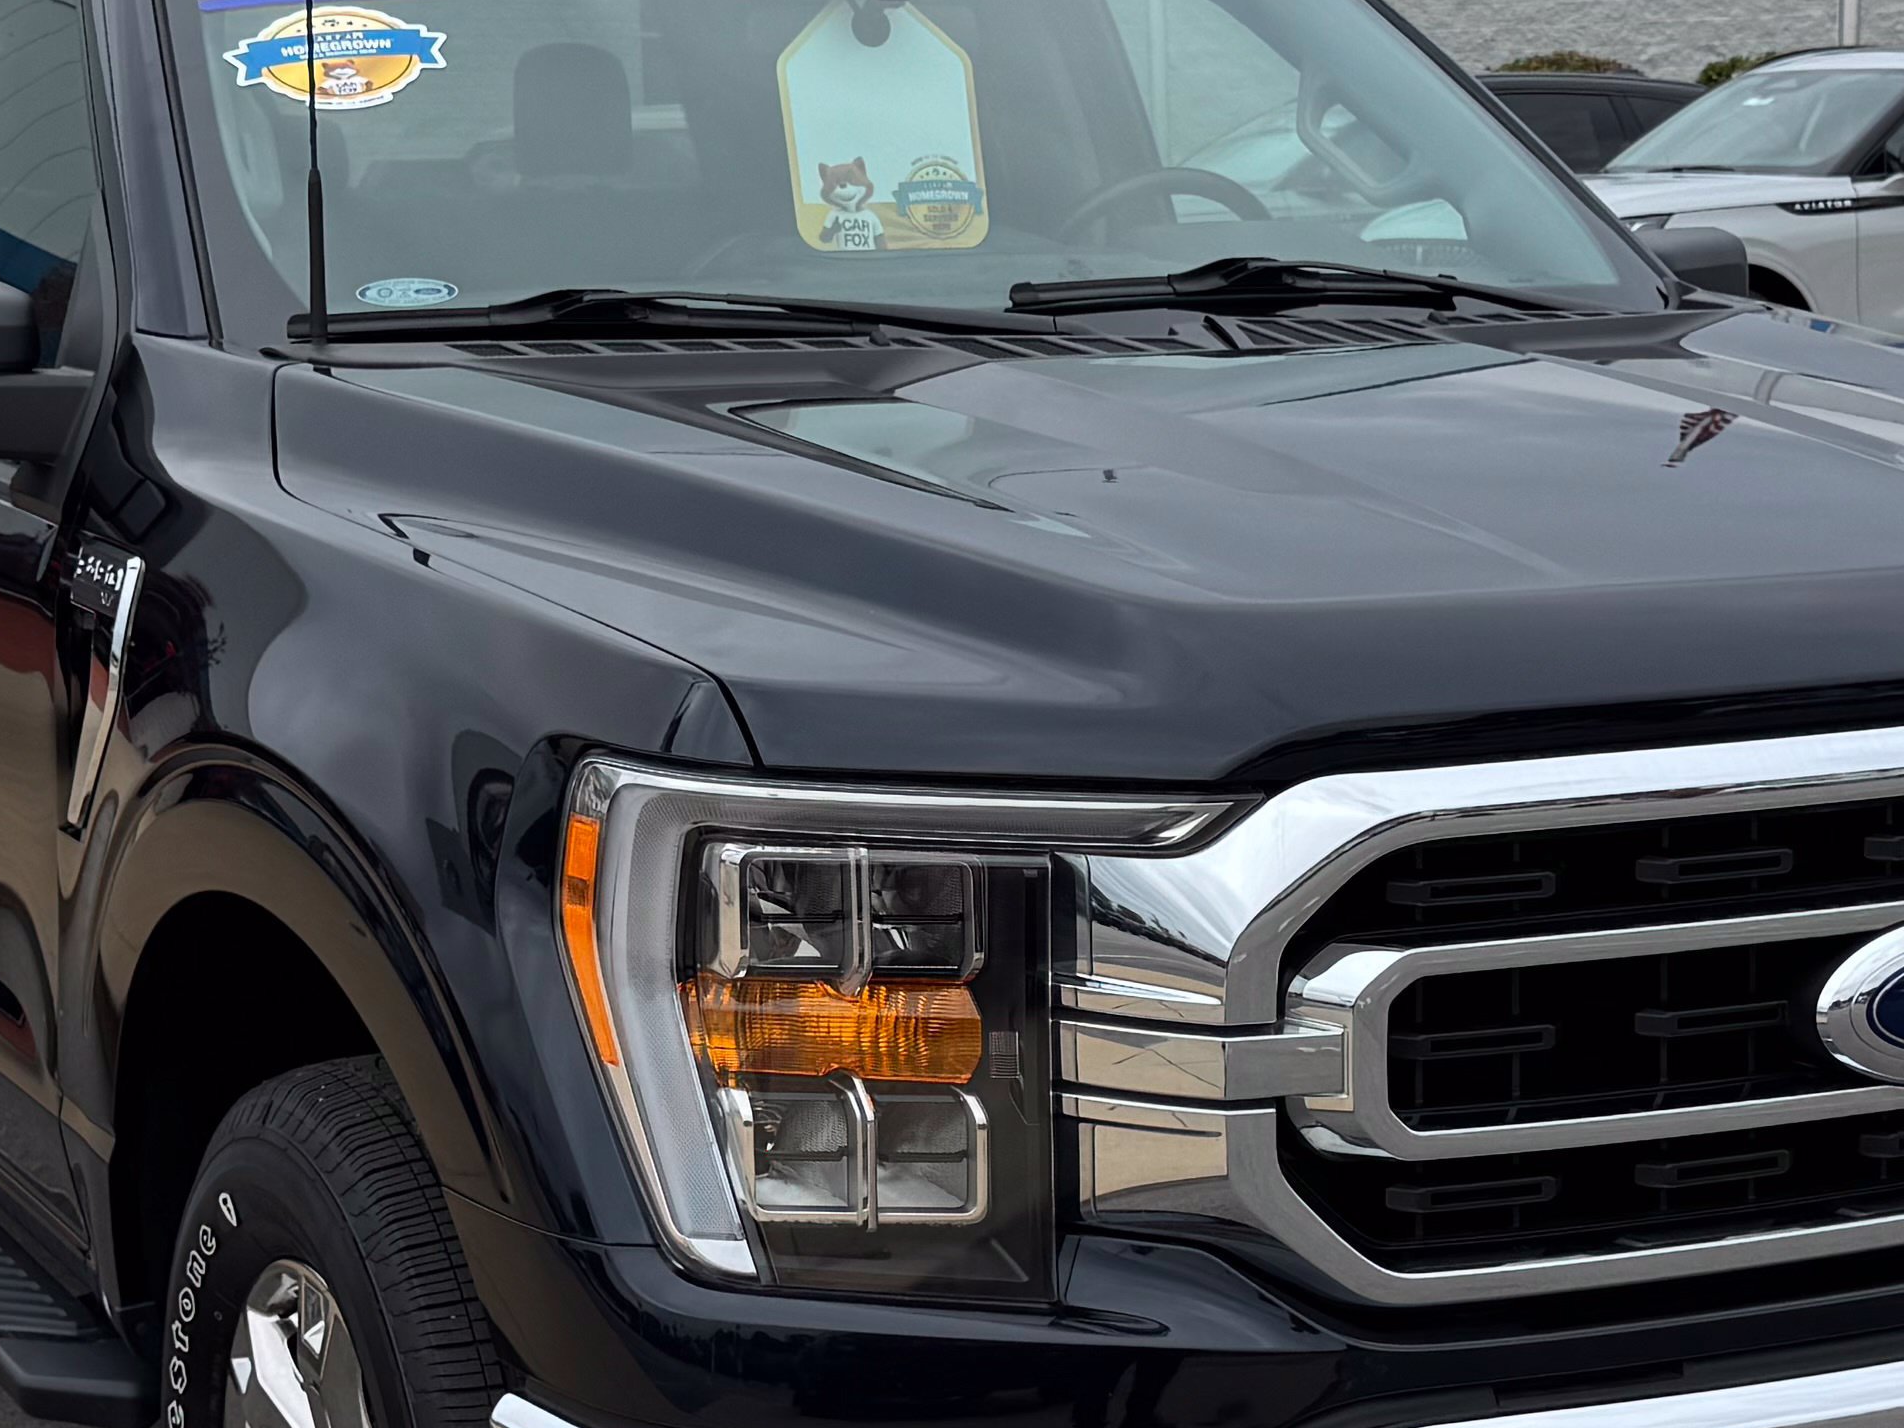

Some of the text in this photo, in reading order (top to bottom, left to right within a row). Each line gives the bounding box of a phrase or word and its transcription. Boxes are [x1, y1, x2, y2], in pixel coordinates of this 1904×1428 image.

[908, 189, 969, 202] HOMEGROWN
[1794, 199, 1852, 211] AVIATOR
[842, 218, 870, 232] CAR
[844, 233, 871, 248] FOX
